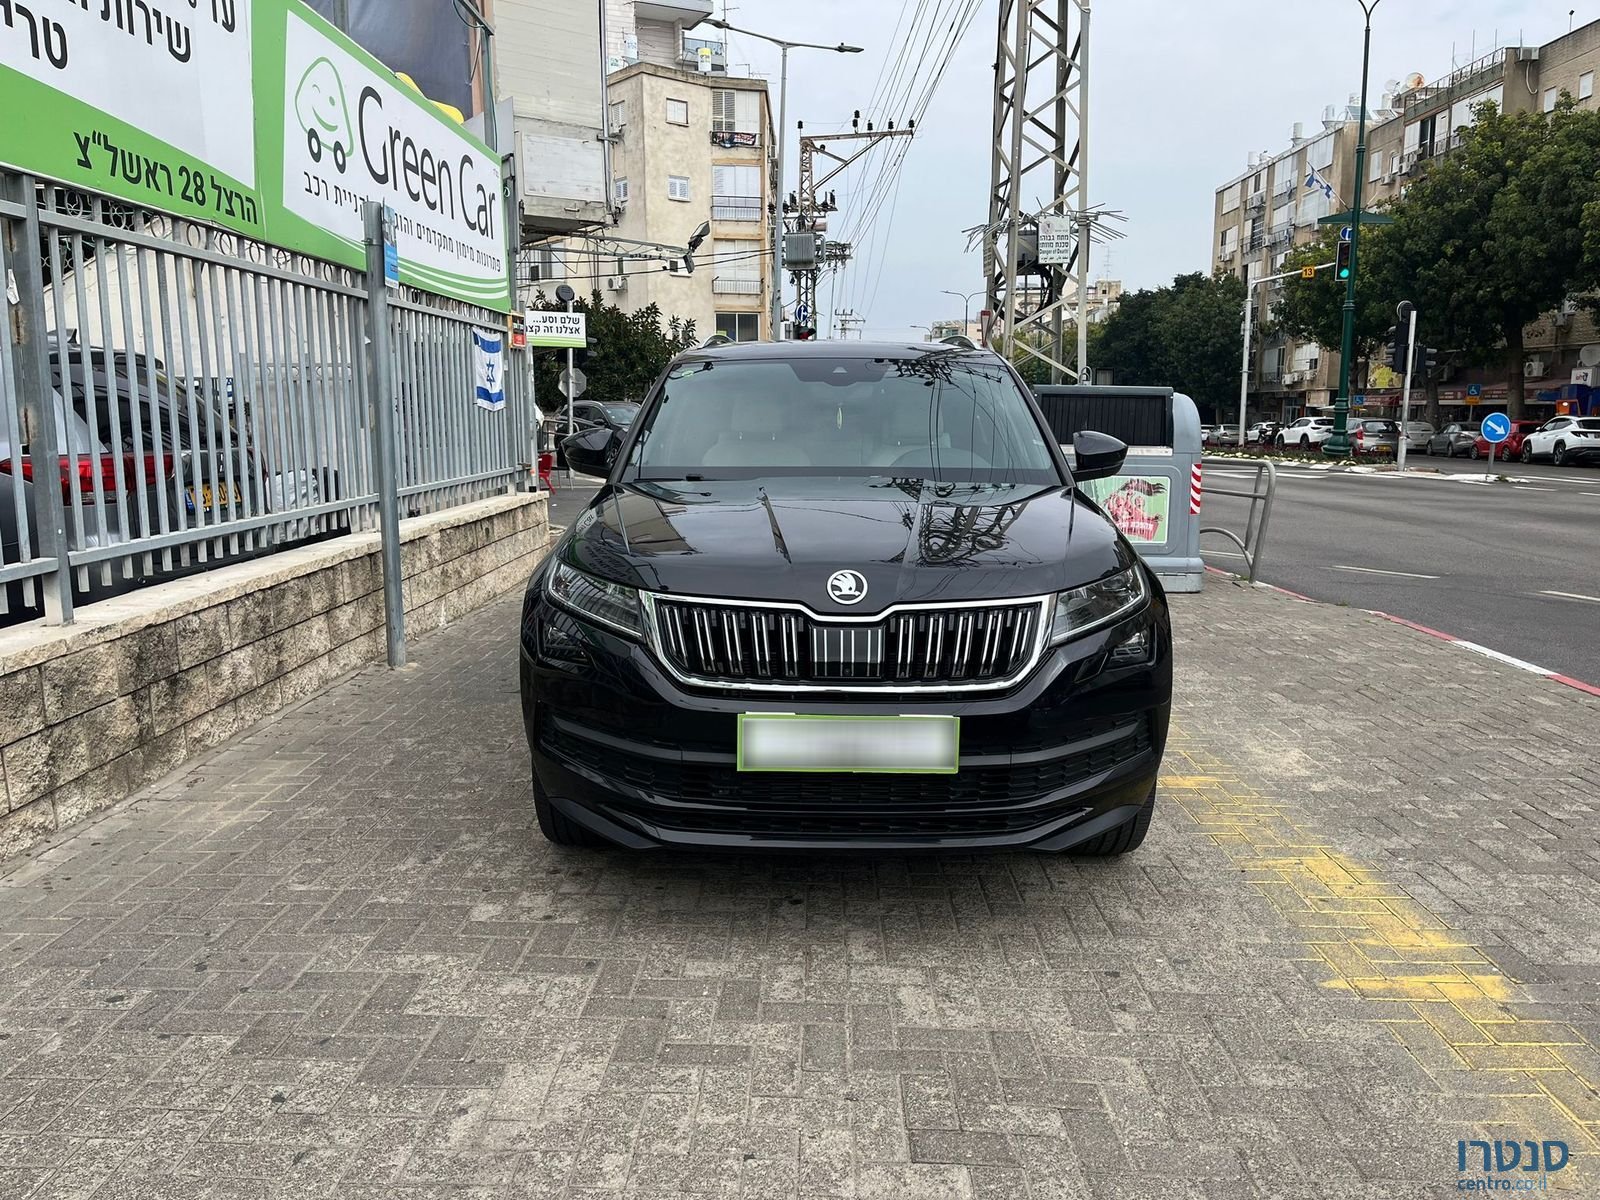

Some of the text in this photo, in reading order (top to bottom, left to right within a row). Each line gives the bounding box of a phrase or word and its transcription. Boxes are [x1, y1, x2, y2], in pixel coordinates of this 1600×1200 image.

[358, 86, 496, 240] Green Car
[73, 130, 258, 225] הרצל 28 ראשל"צ
[303, 170, 329, 201] רכב
[394, 212, 413, 236] והוג
[416, 222, 454, 253] מתקדמים
[455, 240, 475, 261] מימון
[476, 249, 501, 273] פתרונות
[1303, 267, 1313, 277] 13
[543, 325, 554, 334] זה
[555, 324, 581, 335] אצלנו
[560, 315, 580, 325] שלם
